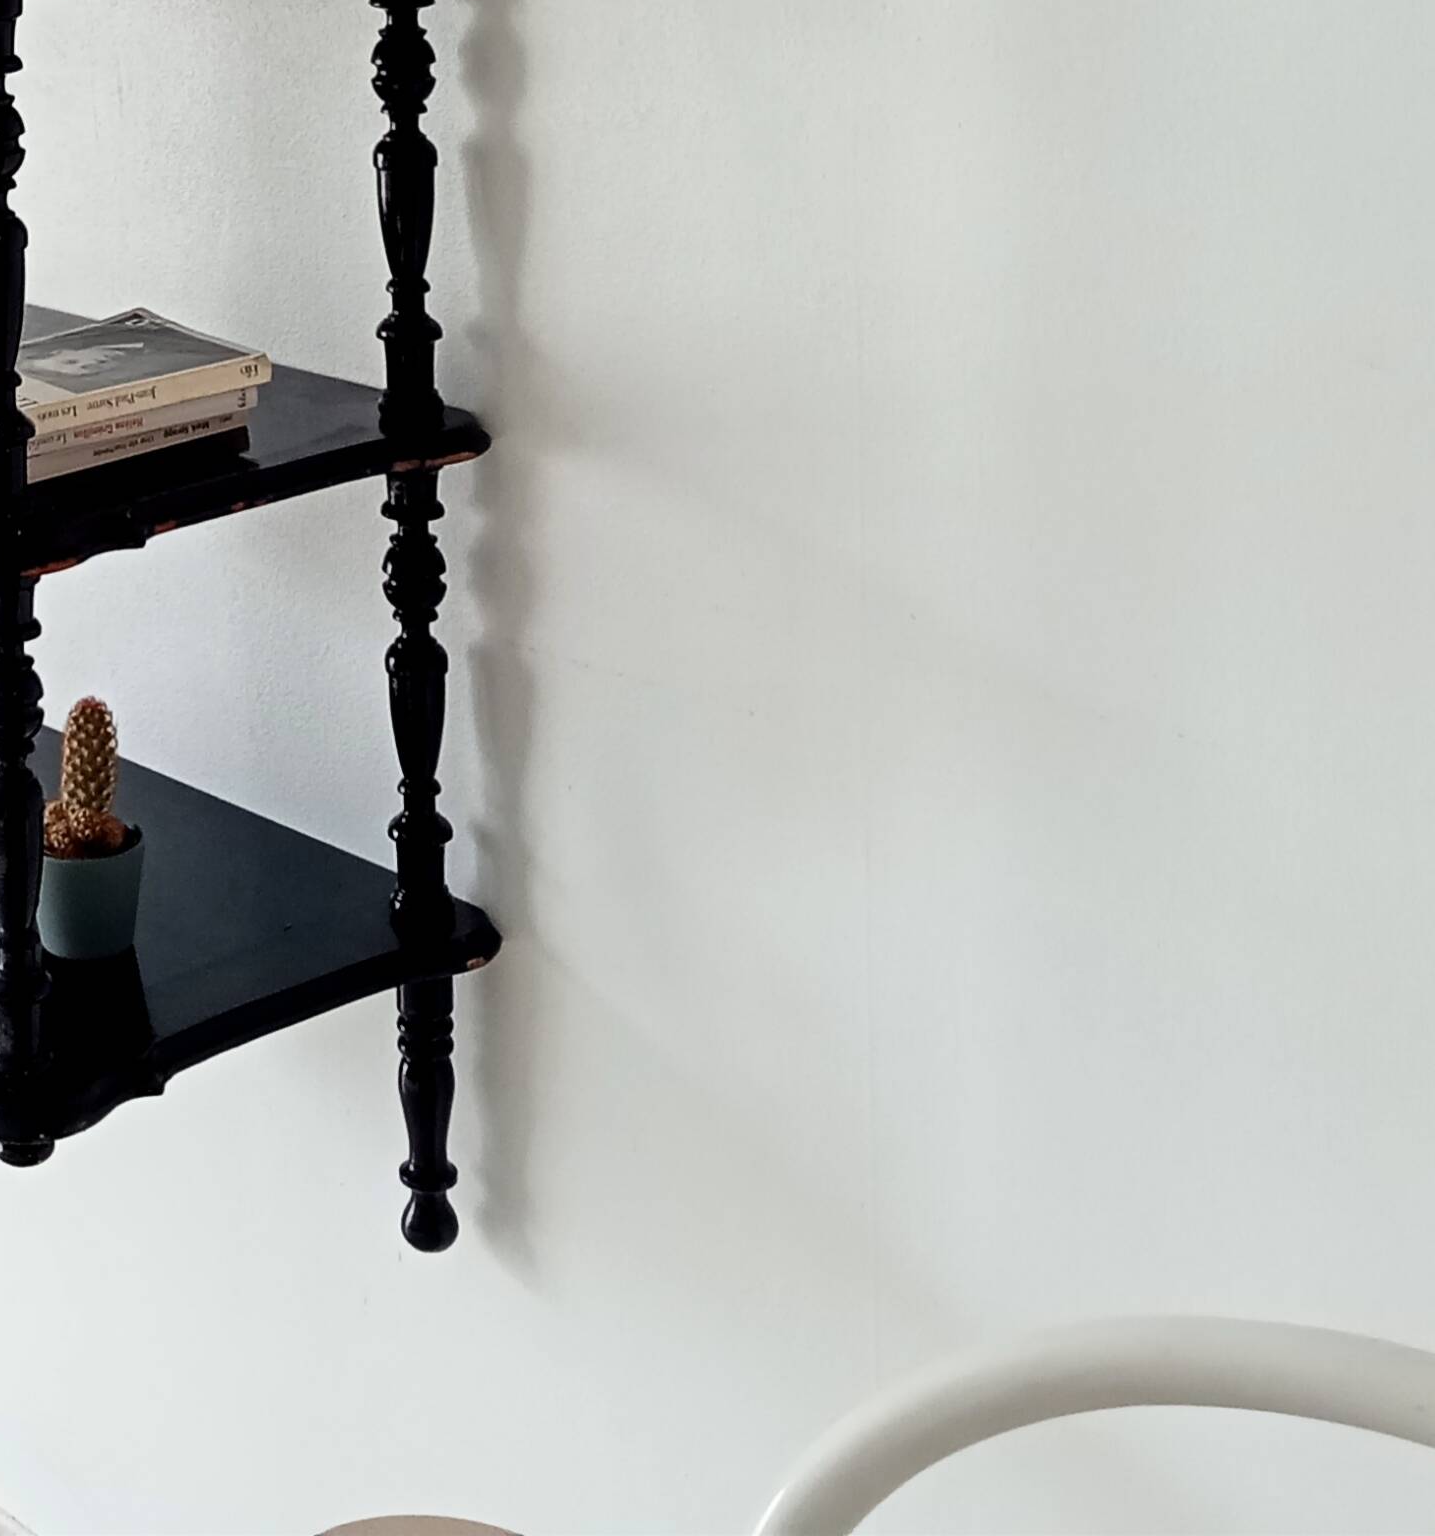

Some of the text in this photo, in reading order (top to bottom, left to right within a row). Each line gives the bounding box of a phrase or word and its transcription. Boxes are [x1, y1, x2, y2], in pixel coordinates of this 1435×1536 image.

[86, 396, 115, 411] Sartre
[114, 385, 157, 408] Jean-Paul
[60, 405, 78, 418] Les
